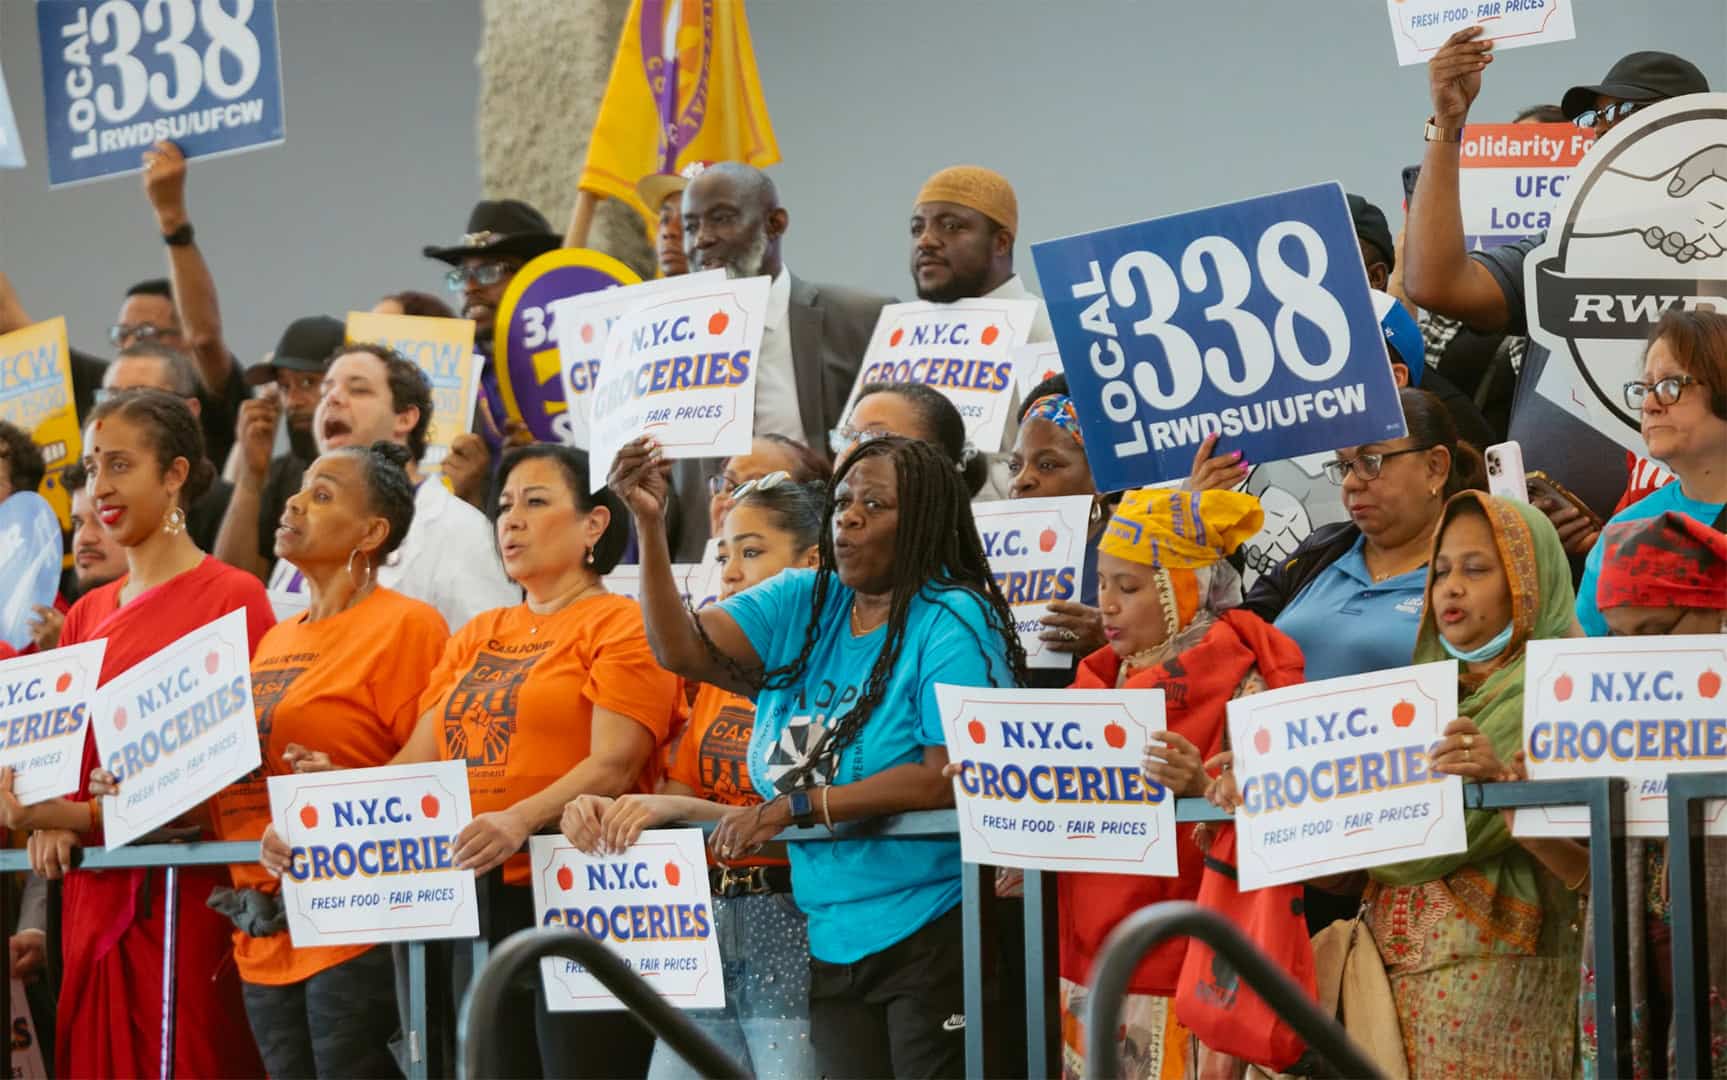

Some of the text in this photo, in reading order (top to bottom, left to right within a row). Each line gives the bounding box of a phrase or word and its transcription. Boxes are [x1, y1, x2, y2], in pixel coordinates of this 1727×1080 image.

[1411, 10, 1439, 28] FRESH
[1443, 4, 1468, 22] FOOD
[1477, 0, 1501, 17] FAIR
[91, 0, 261, 123] 338
[61, 7, 97, 160] LOCAL
[100, 99, 264, 153] RWDSU/UFCW
[1515, 176, 1571, 198] UFC
[1491, 207, 1552, 230] Loca
[1110, 221, 1351, 410] 338
[632, 316, 696, 352] N.Y.C.
[909, 323, 971, 346] N.Y.C.
[1072, 260, 1149, 458] LOCAL
[646, 408, 670, 423] FAIR
[675, 405, 723, 421] PRICES
[1150, 384, 1367, 451] RWDSU/UFCW
[136, 667, 199, 718] N.Y.C.
[1590, 671, 1683, 703] N.Y.C.
[107, 675, 248, 784] GROCERIES
[711, 719, 754, 745] CAS
[1000, 721, 1093, 750] N.Y.C.
[1285, 708, 1380, 750] N.Y.C.
[960, 759, 1166, 806] GROCERIES
[333, 797, 413, 828] N.Y.C.
[983, 815, 1147, 836] FRESH FOOD FAIR PRICES
[1263, 802, 1430, 846] FRESH FOOD FAIR PRICES
[289, 834, 461, 883] GROCERIE
[586, 862, 658, 891] N.Y.C.
[311, 888, 455, 910] FRESH FOOD FAIR PRICES
[640, 958, 660, 971] FAIR
[664, 957, 698, 971] PRICES
[950, 1013, 966, 1025] NIK
